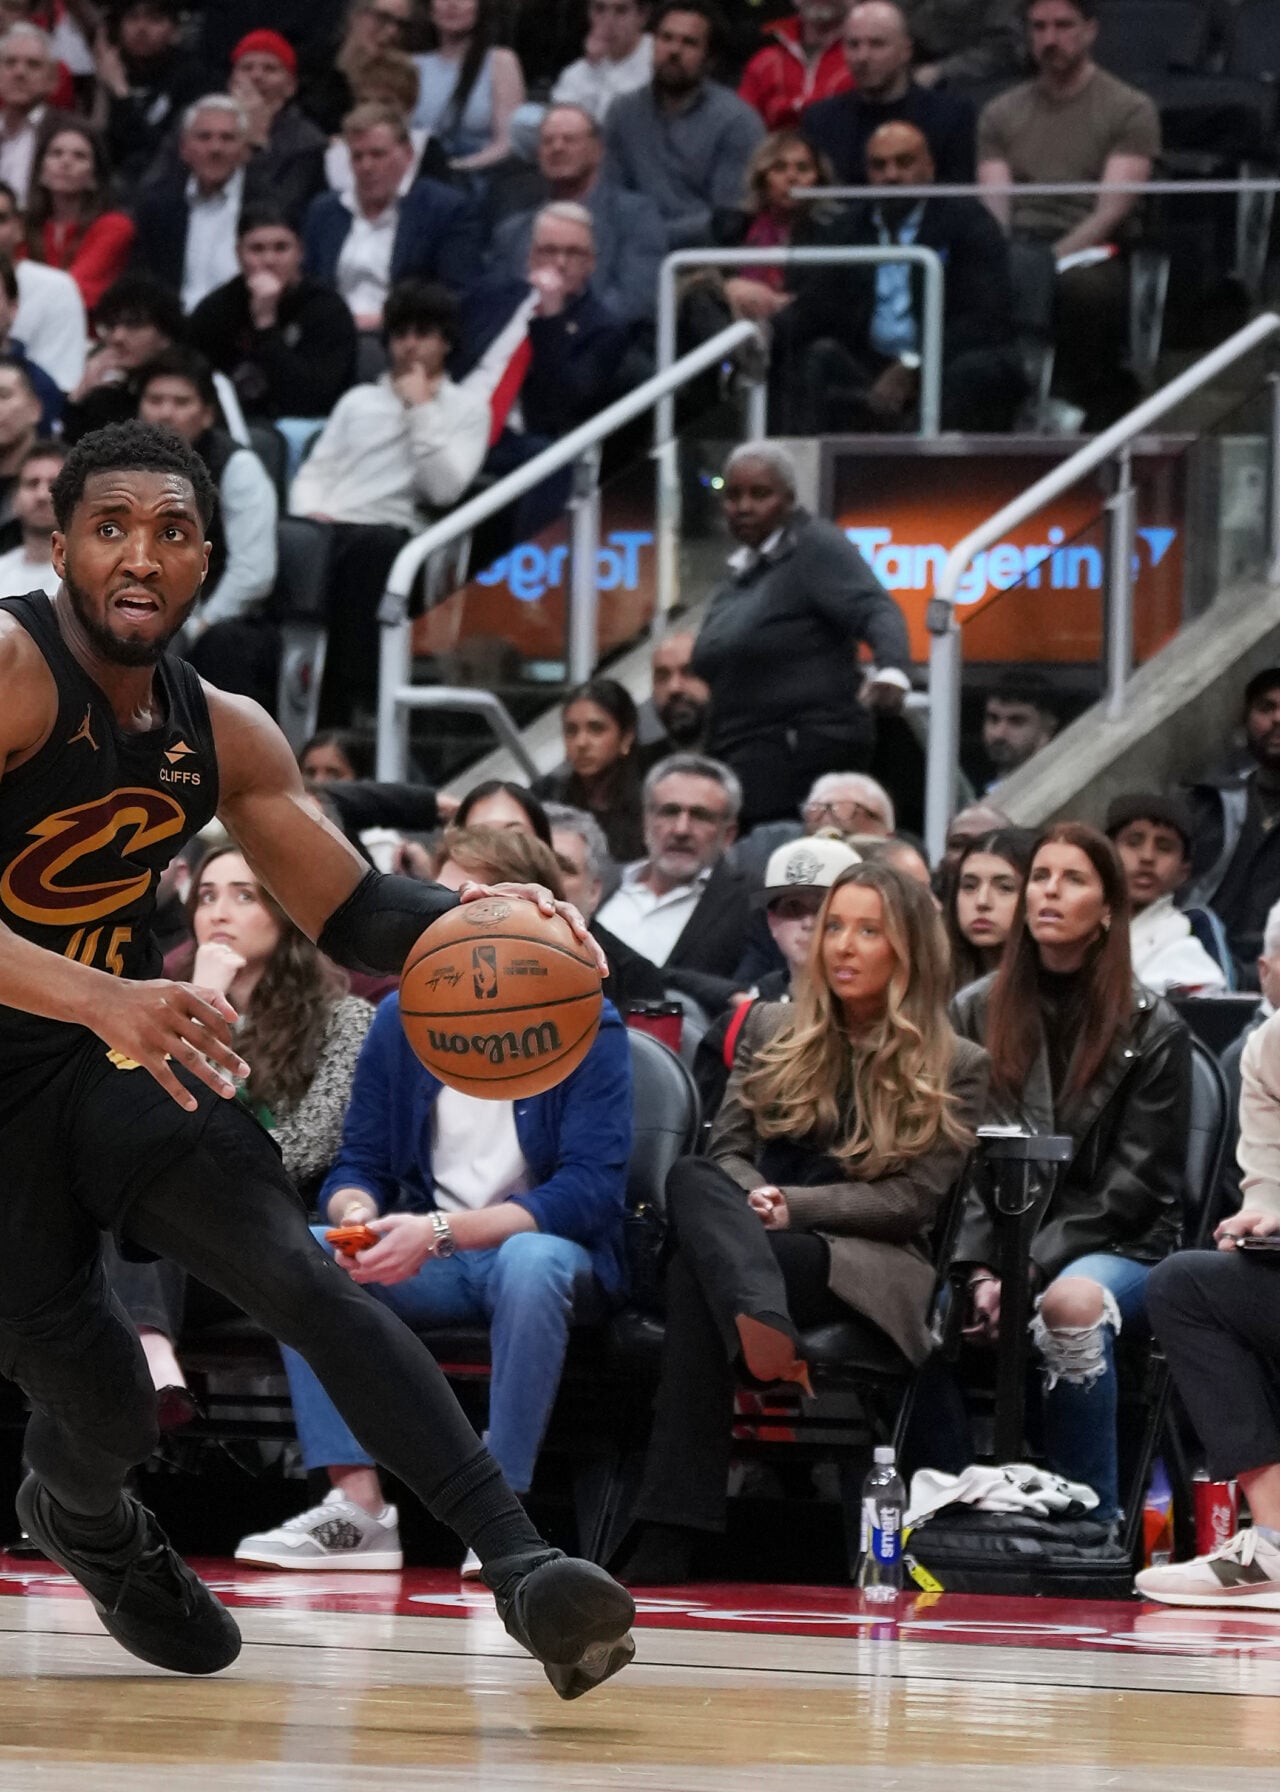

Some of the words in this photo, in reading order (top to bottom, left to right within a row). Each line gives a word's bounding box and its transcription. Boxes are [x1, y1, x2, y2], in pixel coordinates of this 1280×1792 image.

[845, 526, 1140, 605] Tangerin
[160, 768, 200, 785] CLIFFS
[428, 1021, 562, 1064] Wilson
[880, 1507, 896, 1558] smart
